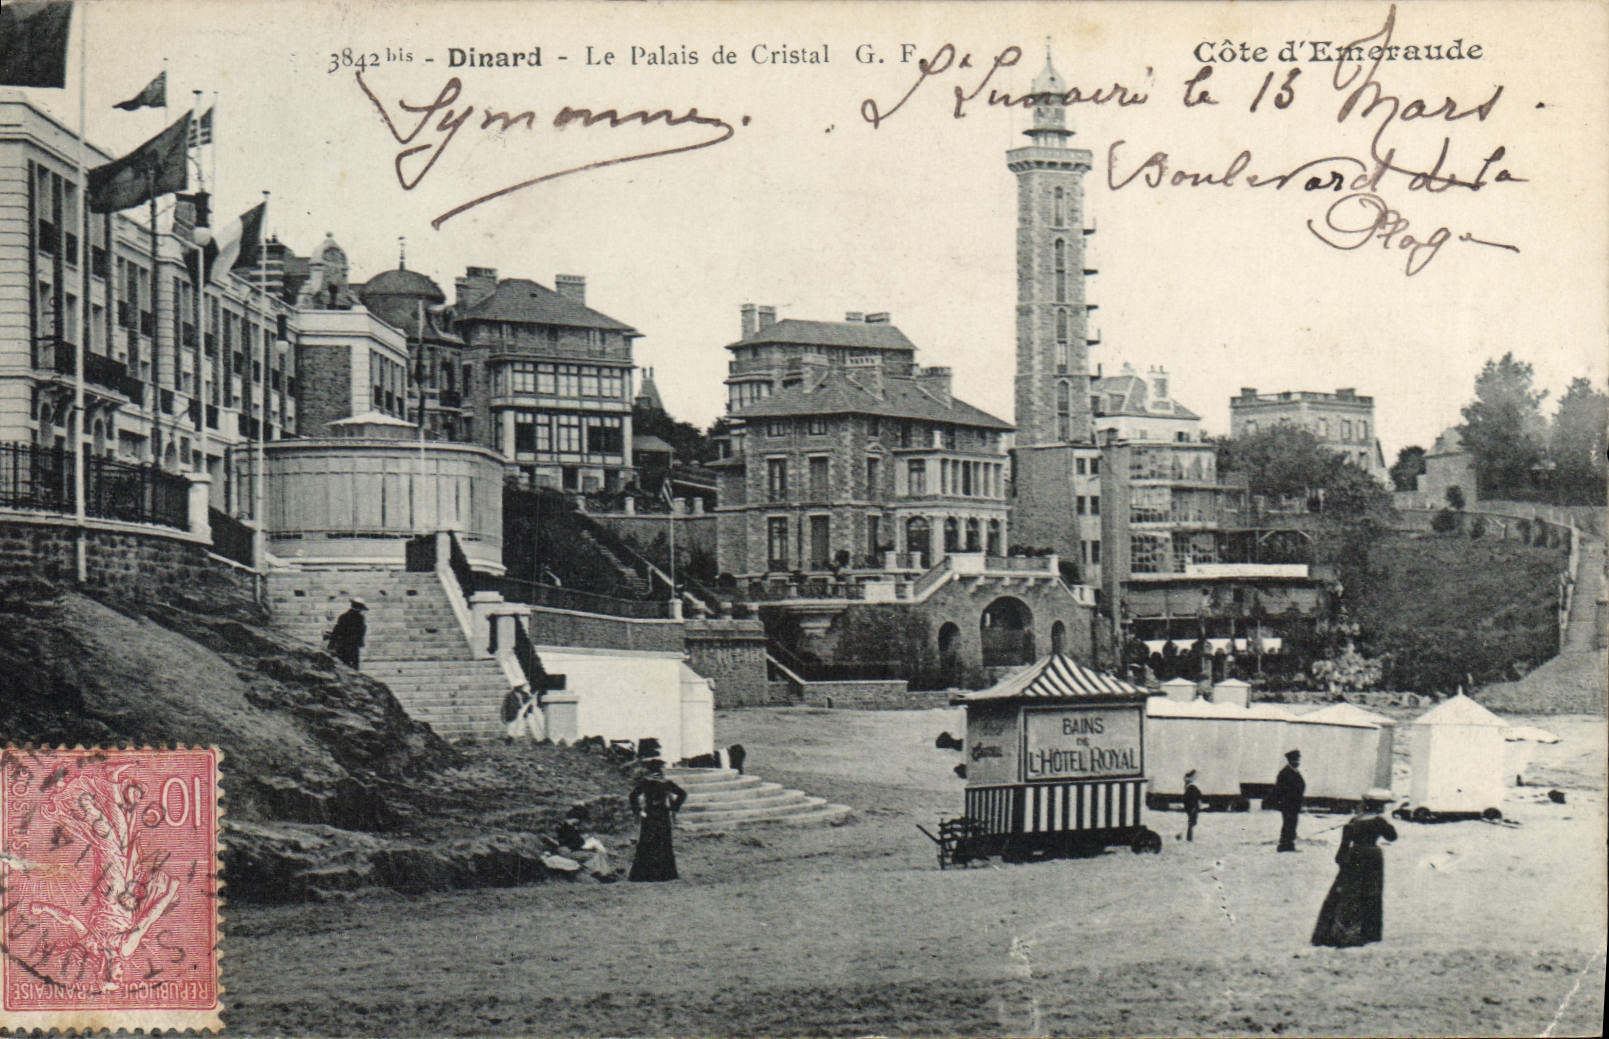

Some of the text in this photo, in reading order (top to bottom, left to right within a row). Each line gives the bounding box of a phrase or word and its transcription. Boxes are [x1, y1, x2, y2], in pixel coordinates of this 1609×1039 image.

[1061, 717, 1105, 735] BAINS
[1076, 737, 1090, 747] DE
[1089, 746, 1139, 772] ROYAL
